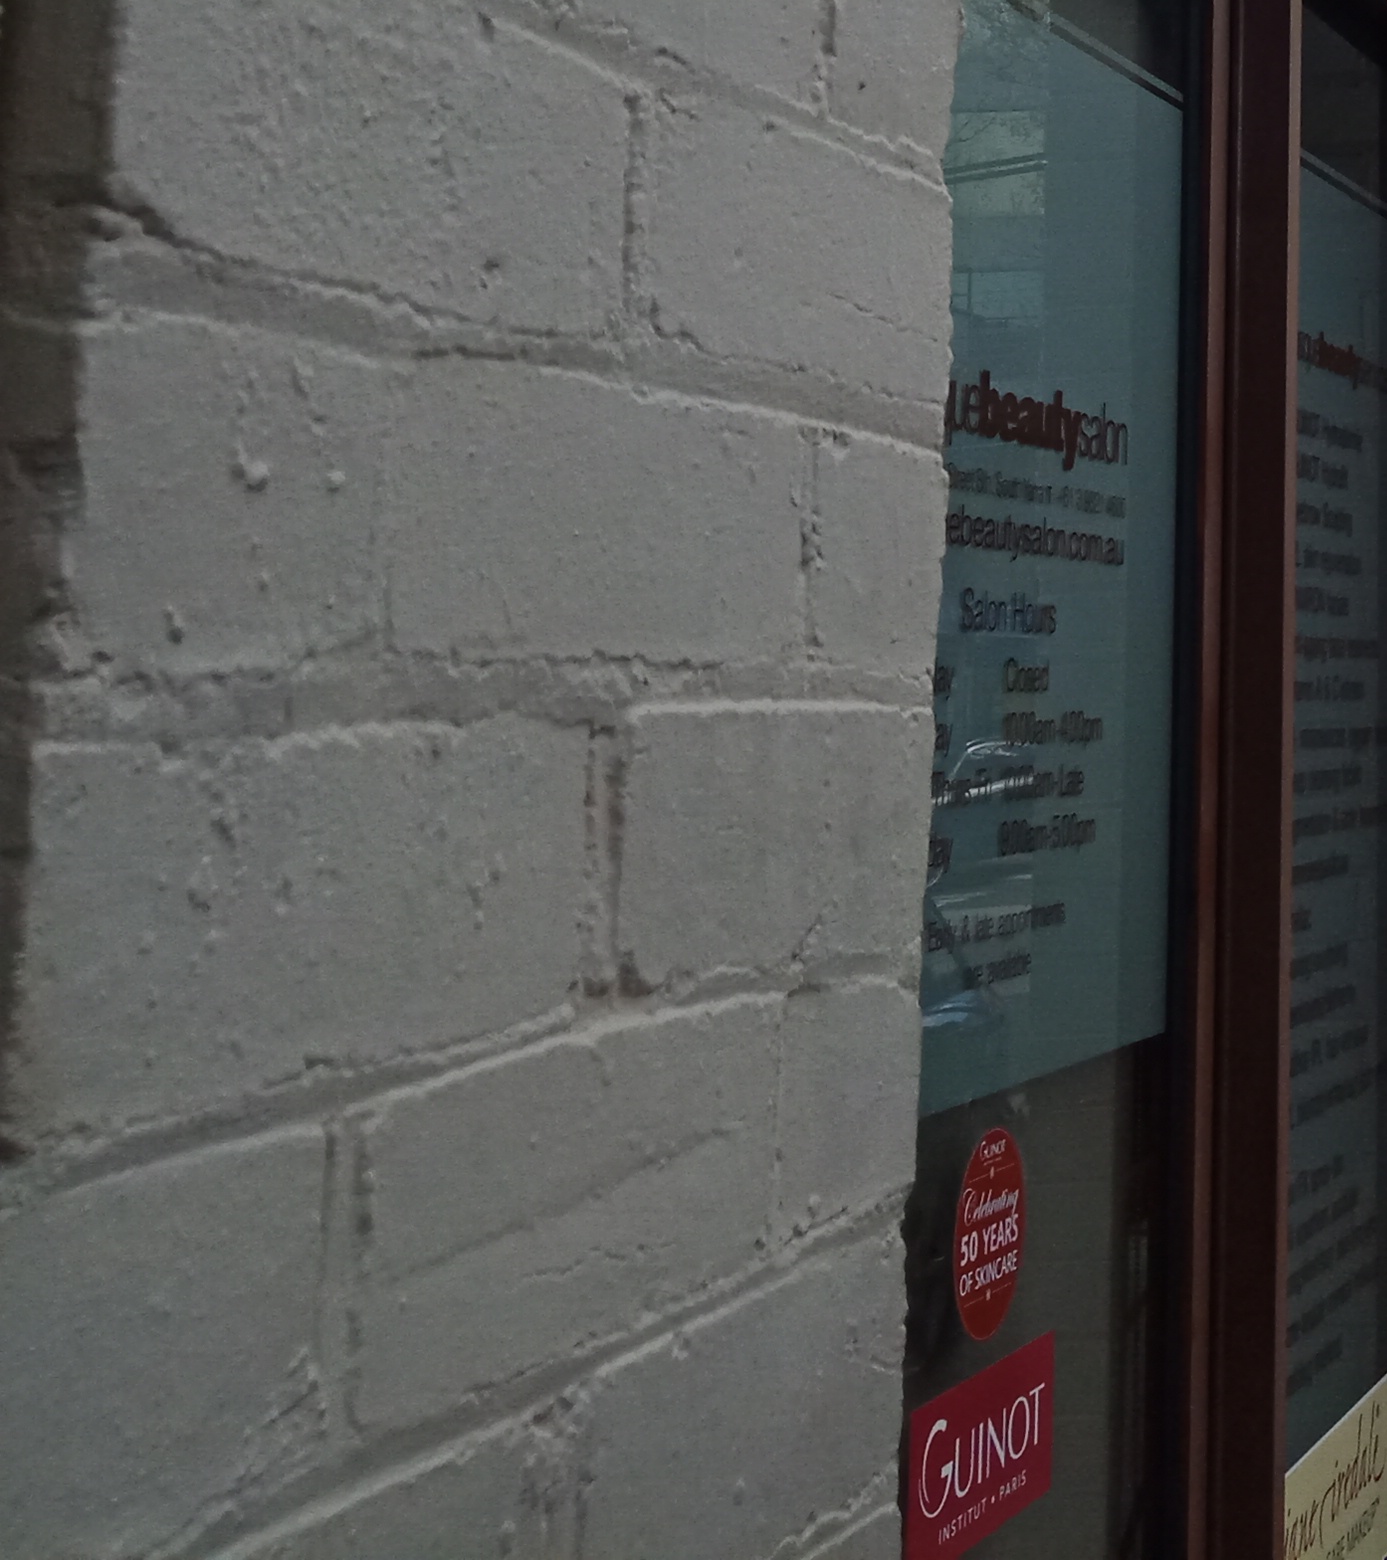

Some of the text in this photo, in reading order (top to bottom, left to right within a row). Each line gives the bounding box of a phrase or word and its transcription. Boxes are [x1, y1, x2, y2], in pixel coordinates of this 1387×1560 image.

[959, 586, 1057, 636] Salon Hours
[1003, 657, 1049, 695] Closed
[962, 1187, 1020, 1227] Celebrating
[960, 1214, 1019, 1267] 50 YEARS
[959, 1249, 1019, 1297] OF SKINCARE
[918, 1382, 1046, 1519] GUINOT
[937, 1468, 1027, 1546] INSTITUT PARIS
